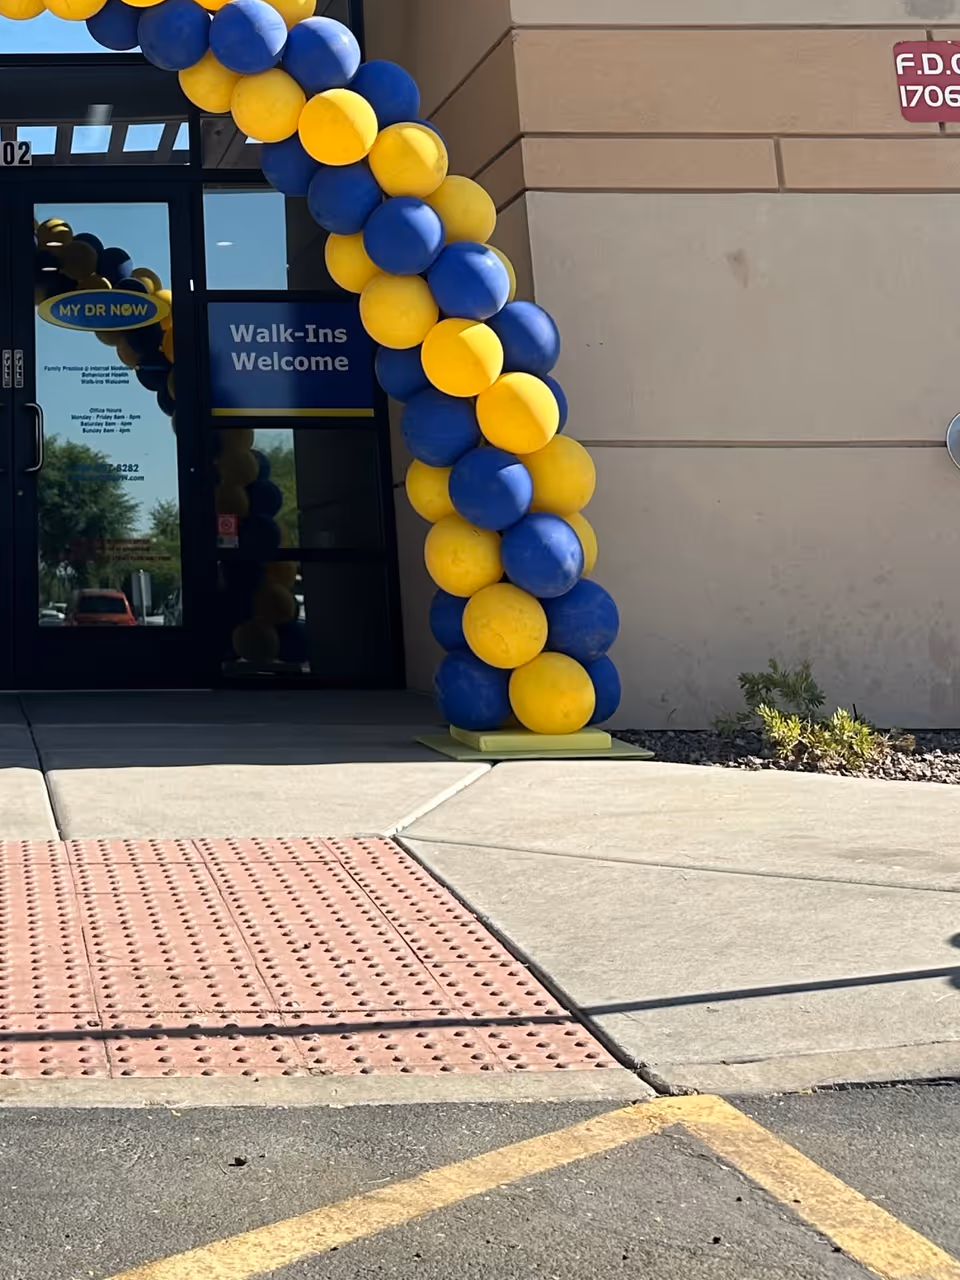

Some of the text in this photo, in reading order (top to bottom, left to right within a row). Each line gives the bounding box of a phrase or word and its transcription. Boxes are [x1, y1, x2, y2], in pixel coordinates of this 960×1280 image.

[59, 303, 148, 316] MY DR NOW
[229, 324, 347, 343] Walk-Ins
[231, 352, 349, 371] Welcome
